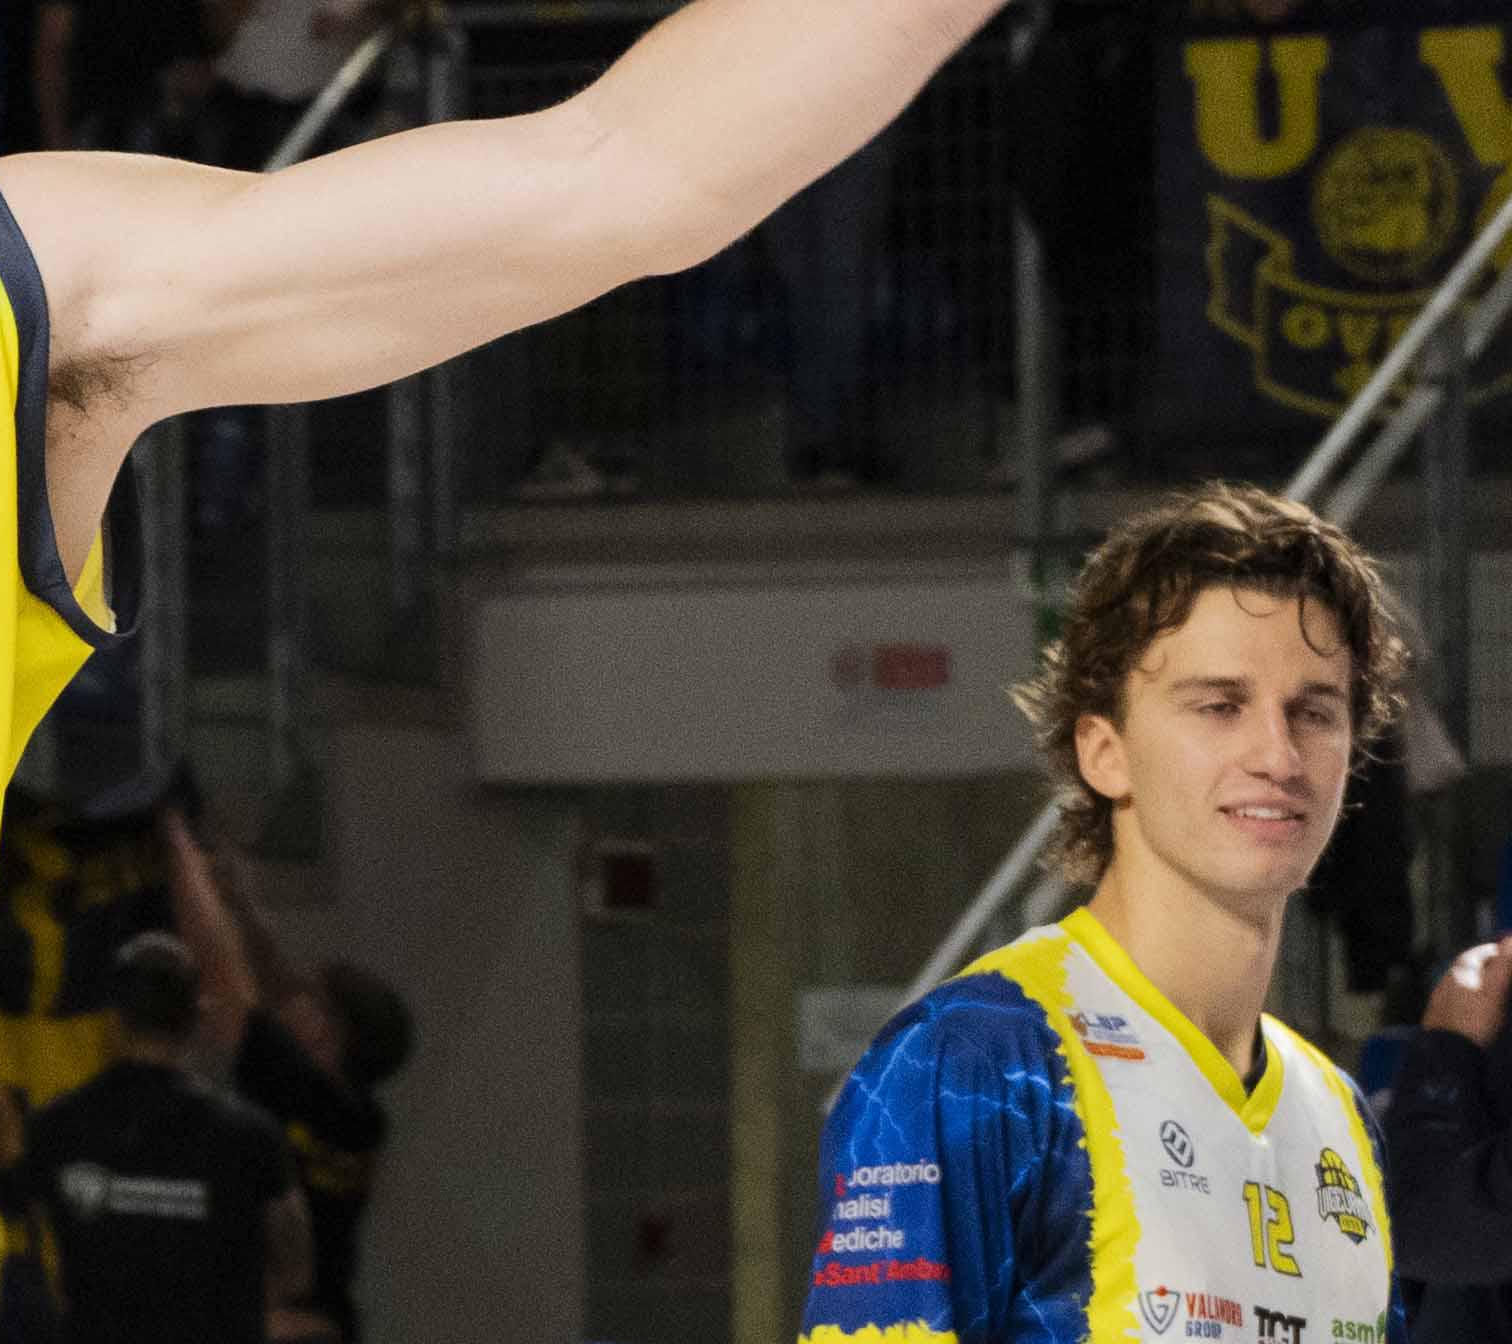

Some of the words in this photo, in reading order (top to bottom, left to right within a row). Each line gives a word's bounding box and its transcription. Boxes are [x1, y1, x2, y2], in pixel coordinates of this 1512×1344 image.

[1159, 1169, 1211, 1195] BITRE
[1243, 1180, 1303, 1278] 12
[1331, 1317, 1374, 1344] asm
